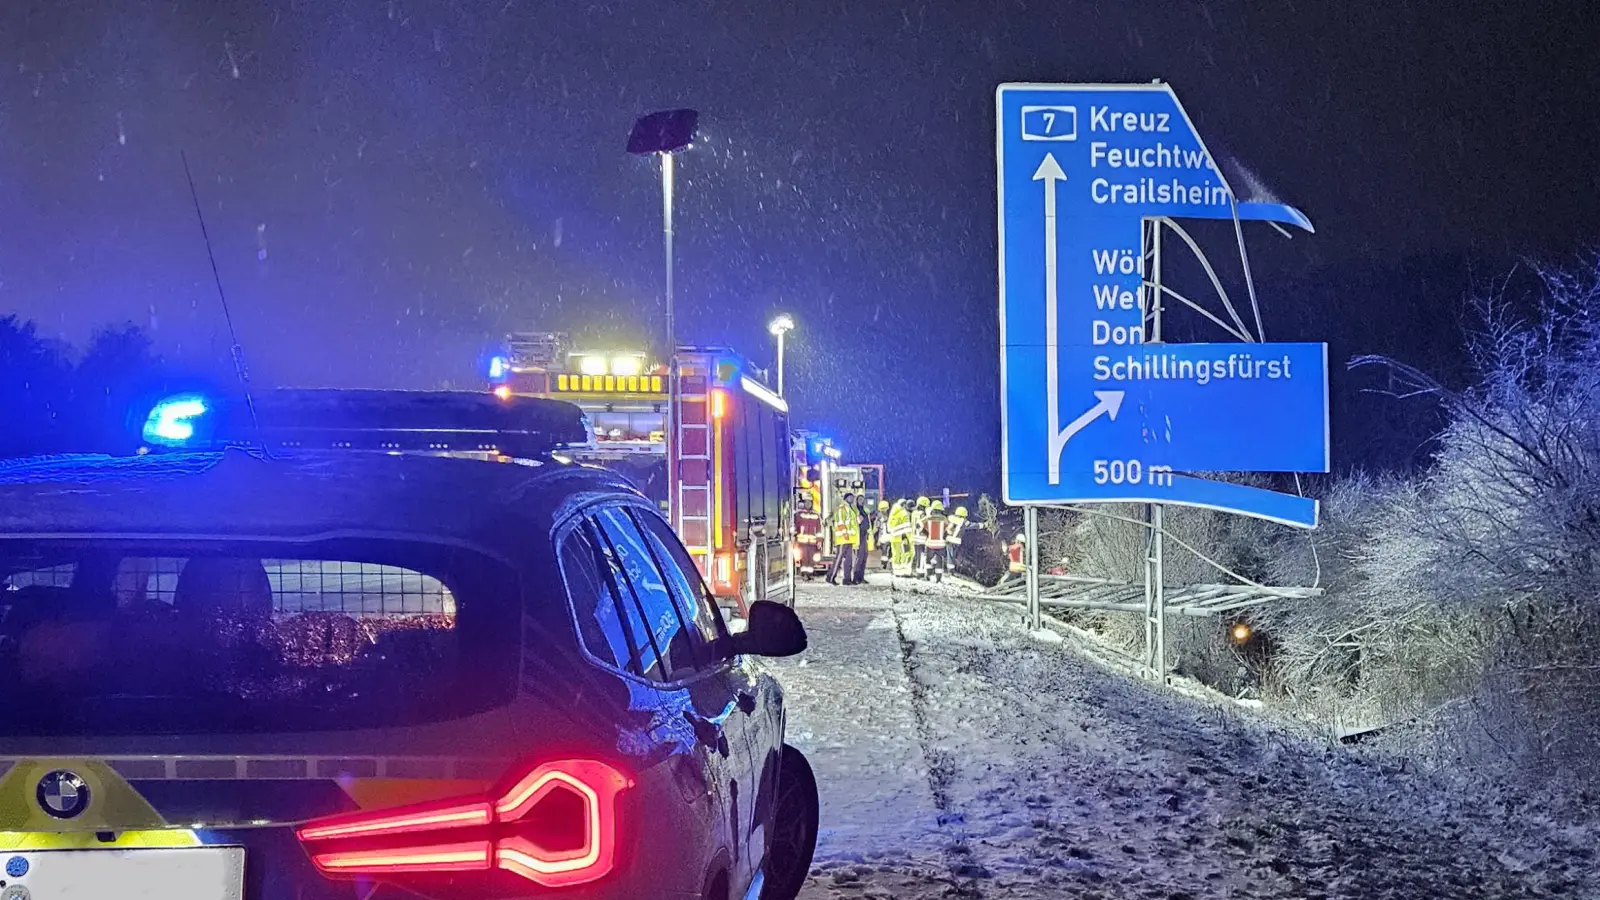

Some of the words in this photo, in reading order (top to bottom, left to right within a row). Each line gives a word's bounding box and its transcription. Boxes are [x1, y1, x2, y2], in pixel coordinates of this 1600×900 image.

[1043, 112, 1055, 134] 7
[1090, 106, 1170, 132] Kreuz
[1093, 354, 1292, 384] Schillingsfürst
[1093, 460, 1142, 485] 500
[1148, 463, 1173, 487] m
